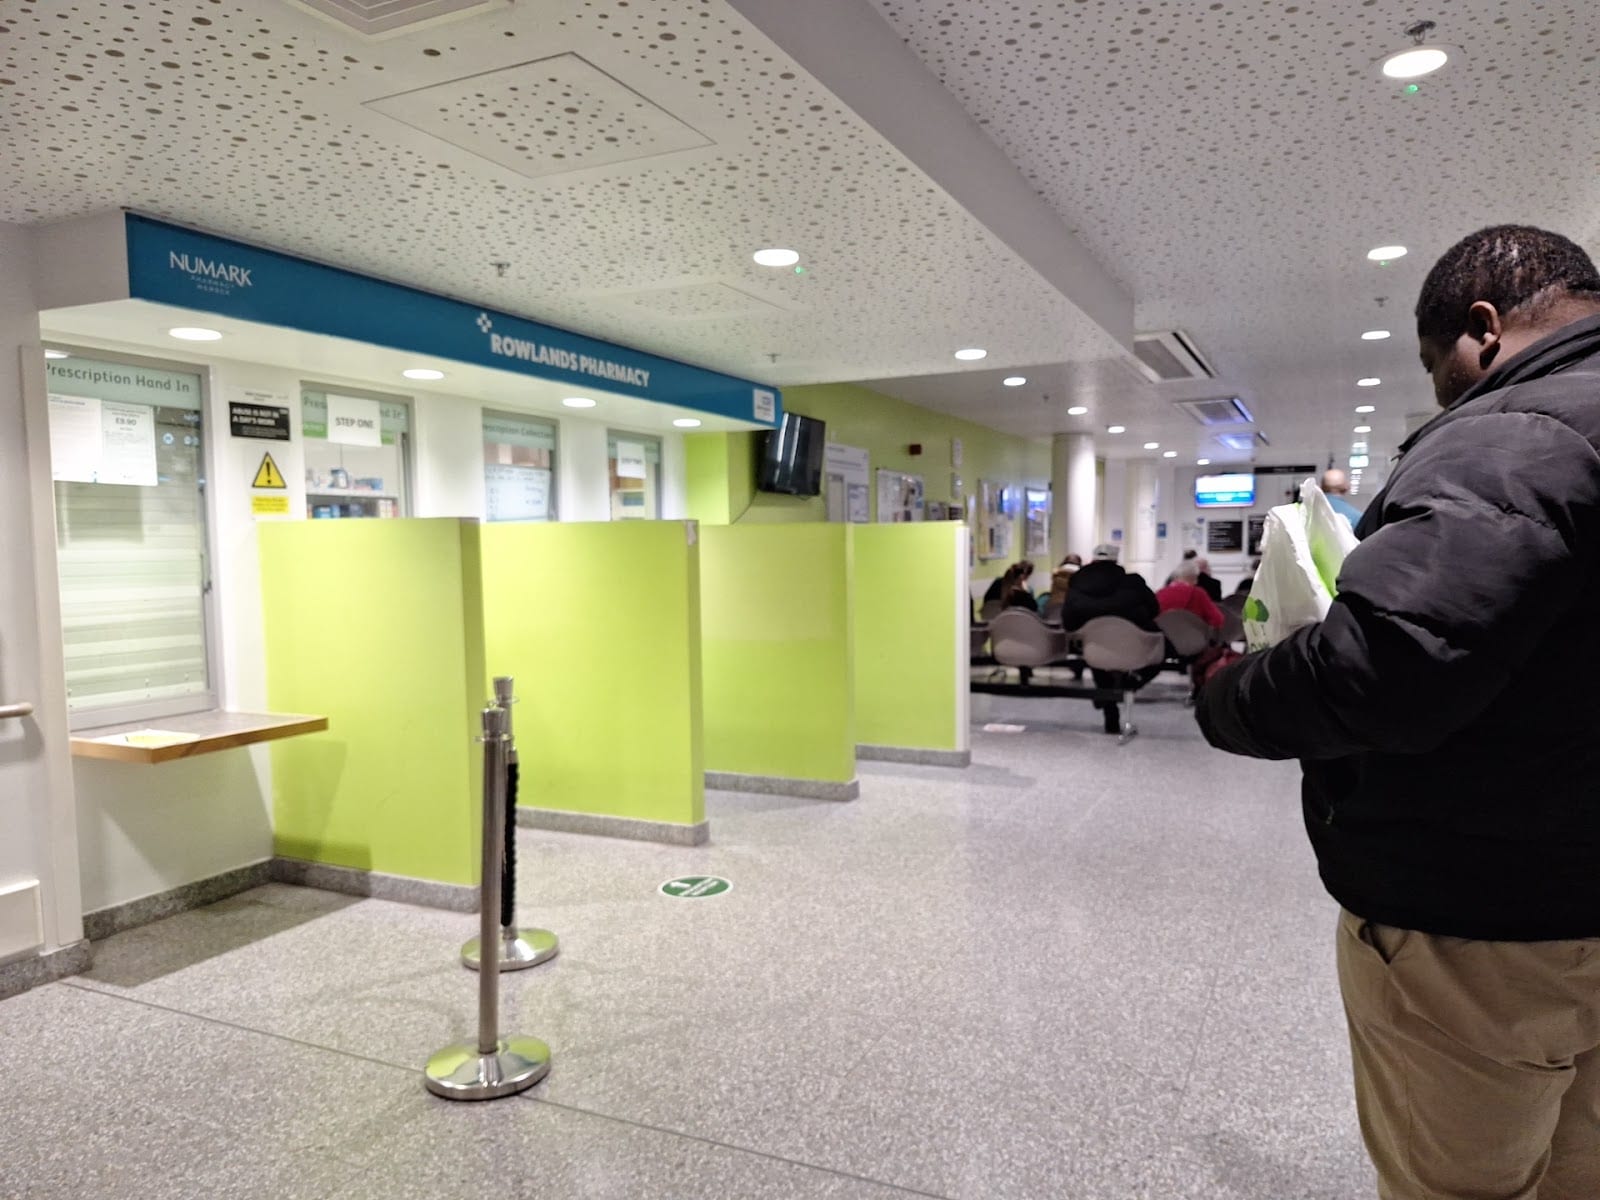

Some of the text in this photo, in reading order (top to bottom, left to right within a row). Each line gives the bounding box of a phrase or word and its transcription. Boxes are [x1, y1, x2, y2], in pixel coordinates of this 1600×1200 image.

[169, 250, 253, 287] NUMARK
[490, 332, 651, 388] ROWLANDS PHARMACY
[135, 374, 172, 391] Hand
[176, 379, 191, 393] In
[335, 417, 374, 429] STEP ONE
